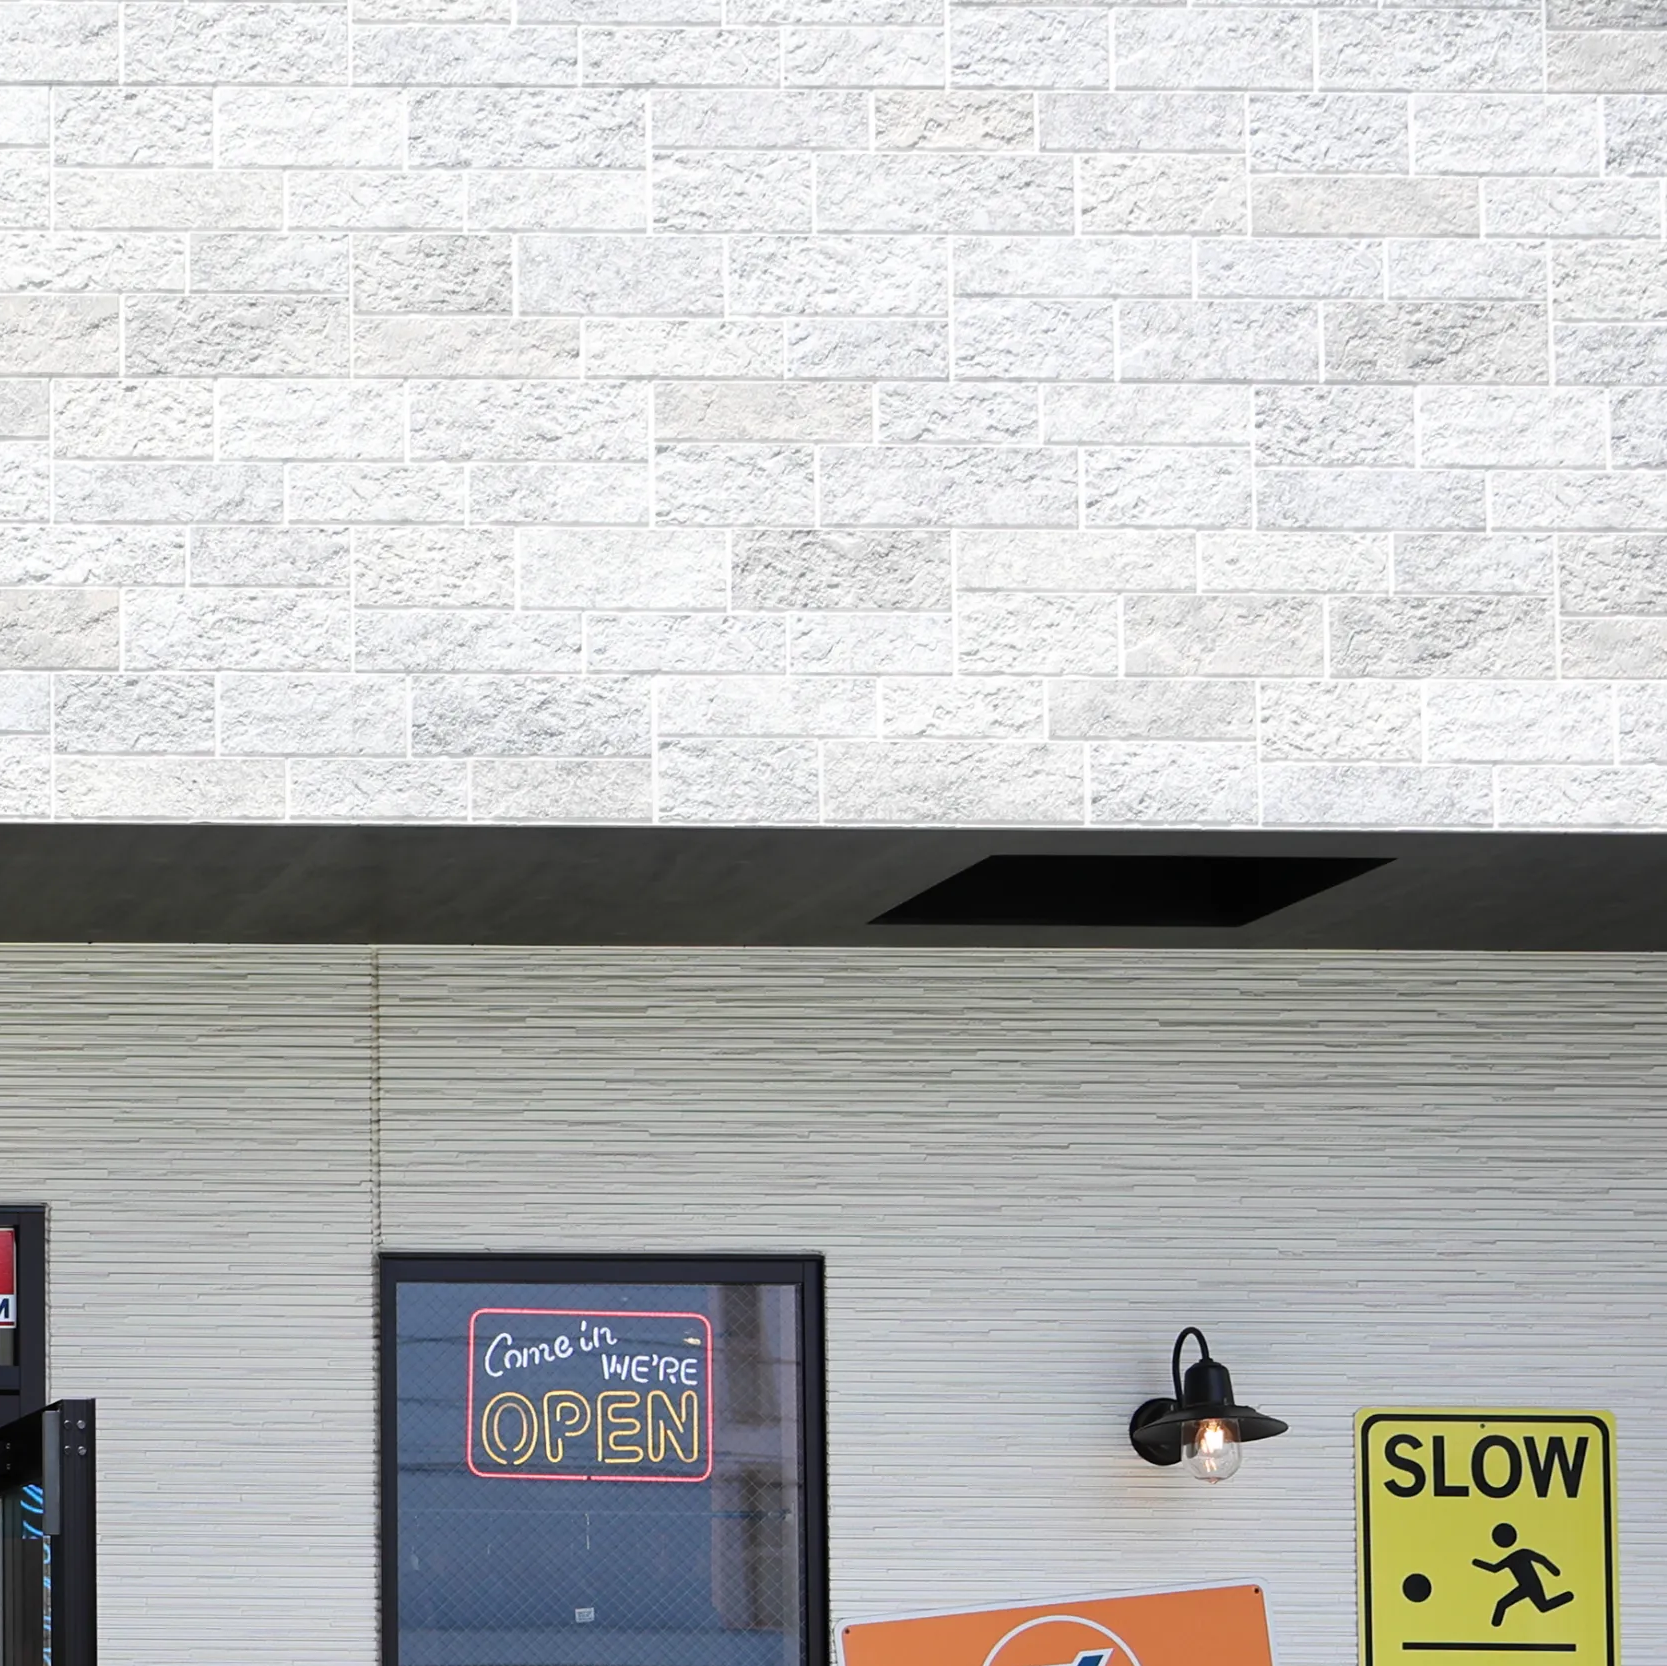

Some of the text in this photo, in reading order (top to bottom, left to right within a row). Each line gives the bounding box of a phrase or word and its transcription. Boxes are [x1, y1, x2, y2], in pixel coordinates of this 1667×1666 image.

[484, 1320, 617, 1378] Come in
[601, 1353, 698, 1385] WE'RE
[481, 1389, 699, 1466] OPEN
[1383, 1432, 1589, 1499] SLOW
